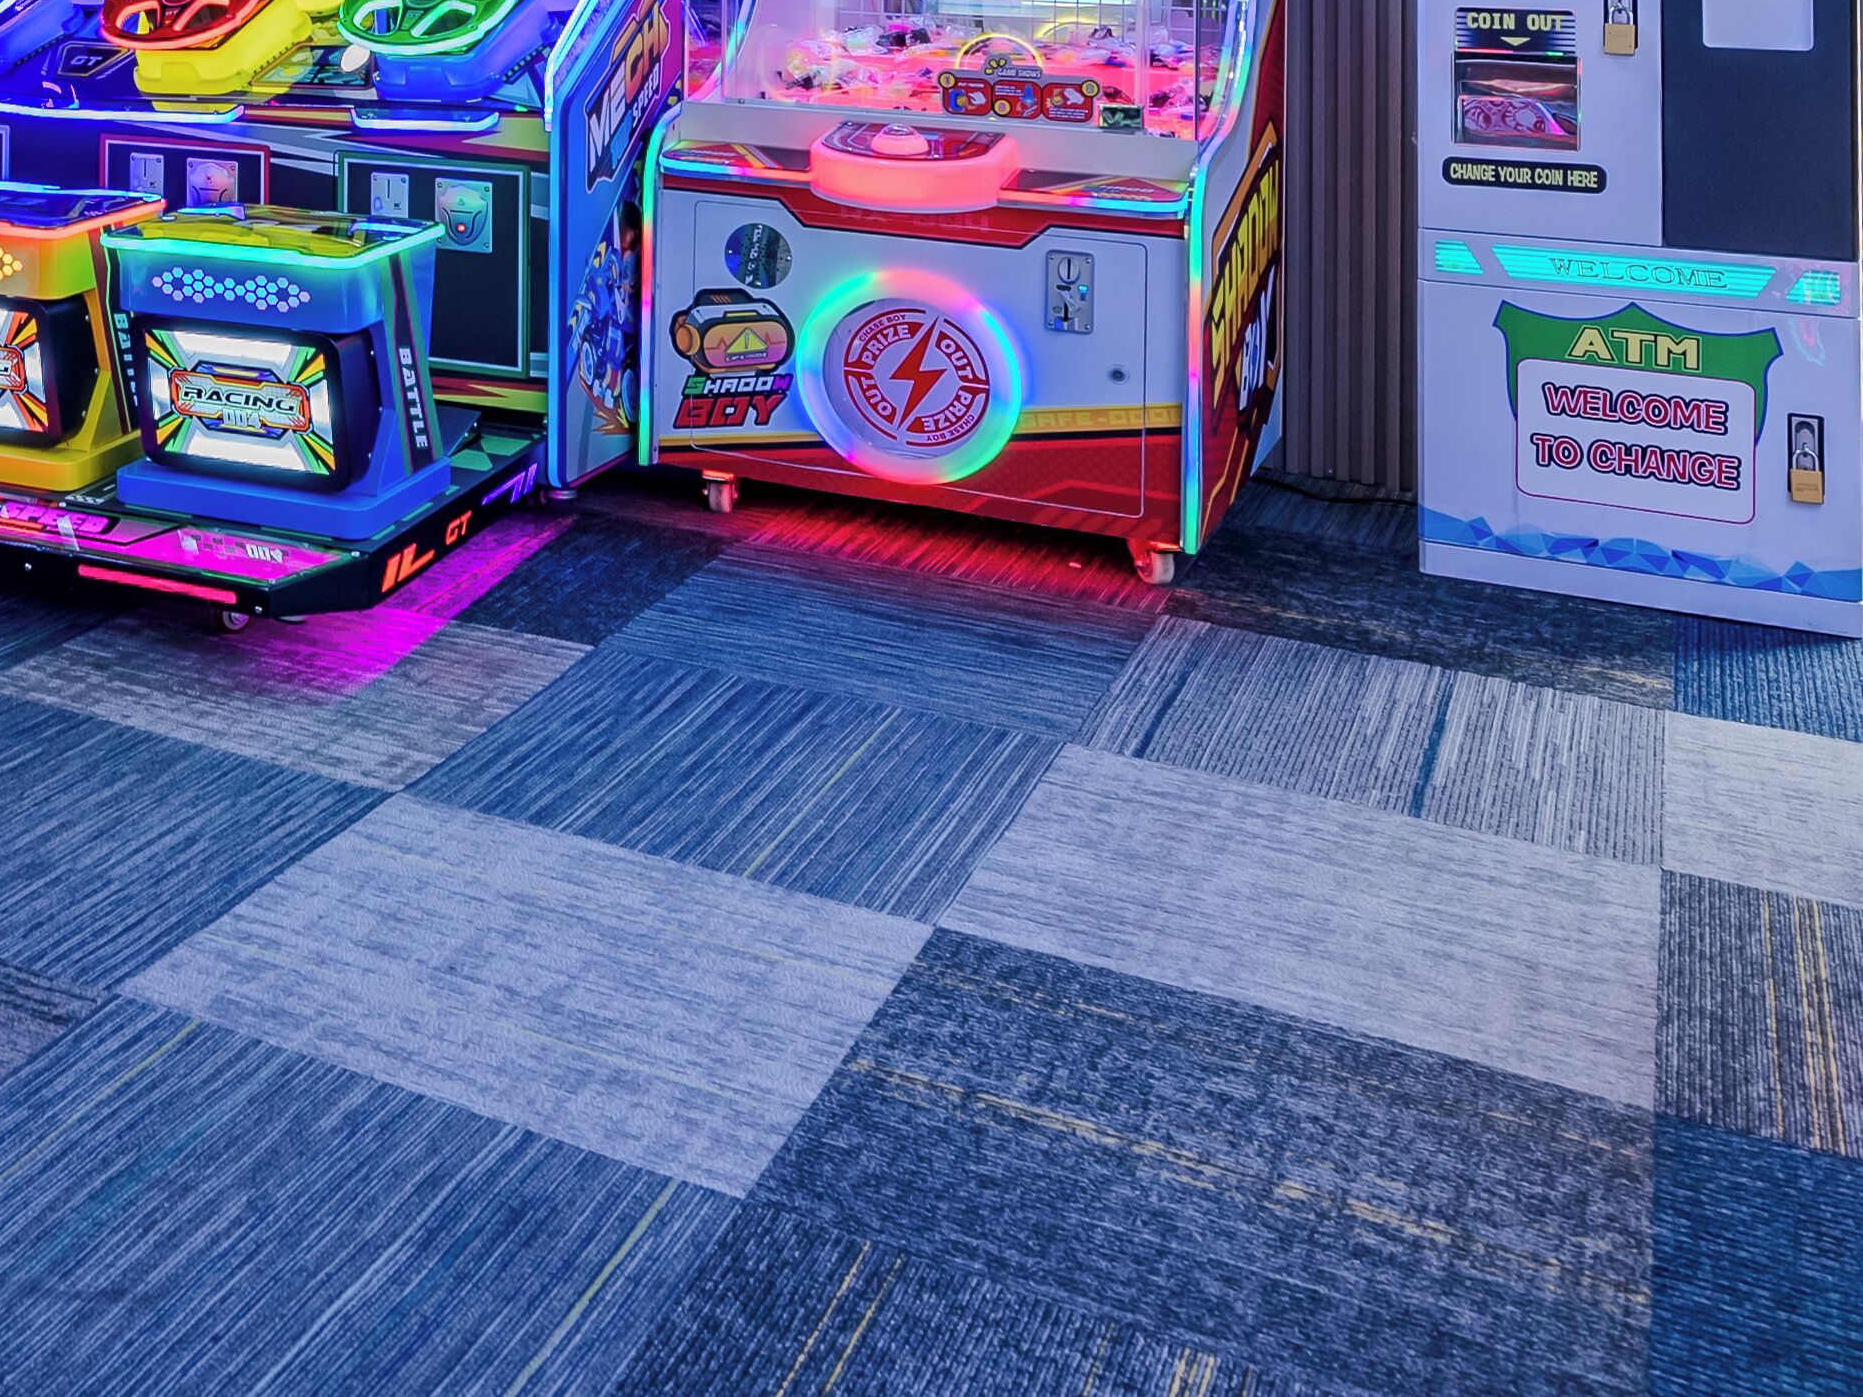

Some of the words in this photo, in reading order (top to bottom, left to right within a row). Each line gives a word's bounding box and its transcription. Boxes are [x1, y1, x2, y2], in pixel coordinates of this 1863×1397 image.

[1465, 12, 1516, 31] COIN
[1526, 13, 1565, 32] OUT
[1450, 163, 1496, 182] CHANGE
[1498, 165, 1532, 184] YOUR
[1534, 168, 1564, 186] COIN
[1567, 170, 1598, 189] HERE
[1547, 256, 1729, 290] WELCOME
[858, 319, 887, 343] CHASE
[886, 314, 907, 324] BOY
[861, 324, 911, 365] PRIZE
[940, 338, 974, 380] OUT
[1567, 325, 1701, 372] ATM
[182, 385, 296, 415] RACING
[399, 347, 428, 450] BATTLE
[684, 376, 793, 395] SHADOW
[860, 376, 894, 417] OUT
[222, 408, 262, 429] 004
[673, 395, 786, 430] BOY
[920, 389, 974, 432] PRIZE
[948, 413, 975, 438] CHASE
[1545, 384, 1729, 435] WELCOME
[925, 432, 947, 443] BOY
[1533, 436, 1581, 468] TO
[1589, 443, 1739, 490] CHANGE
